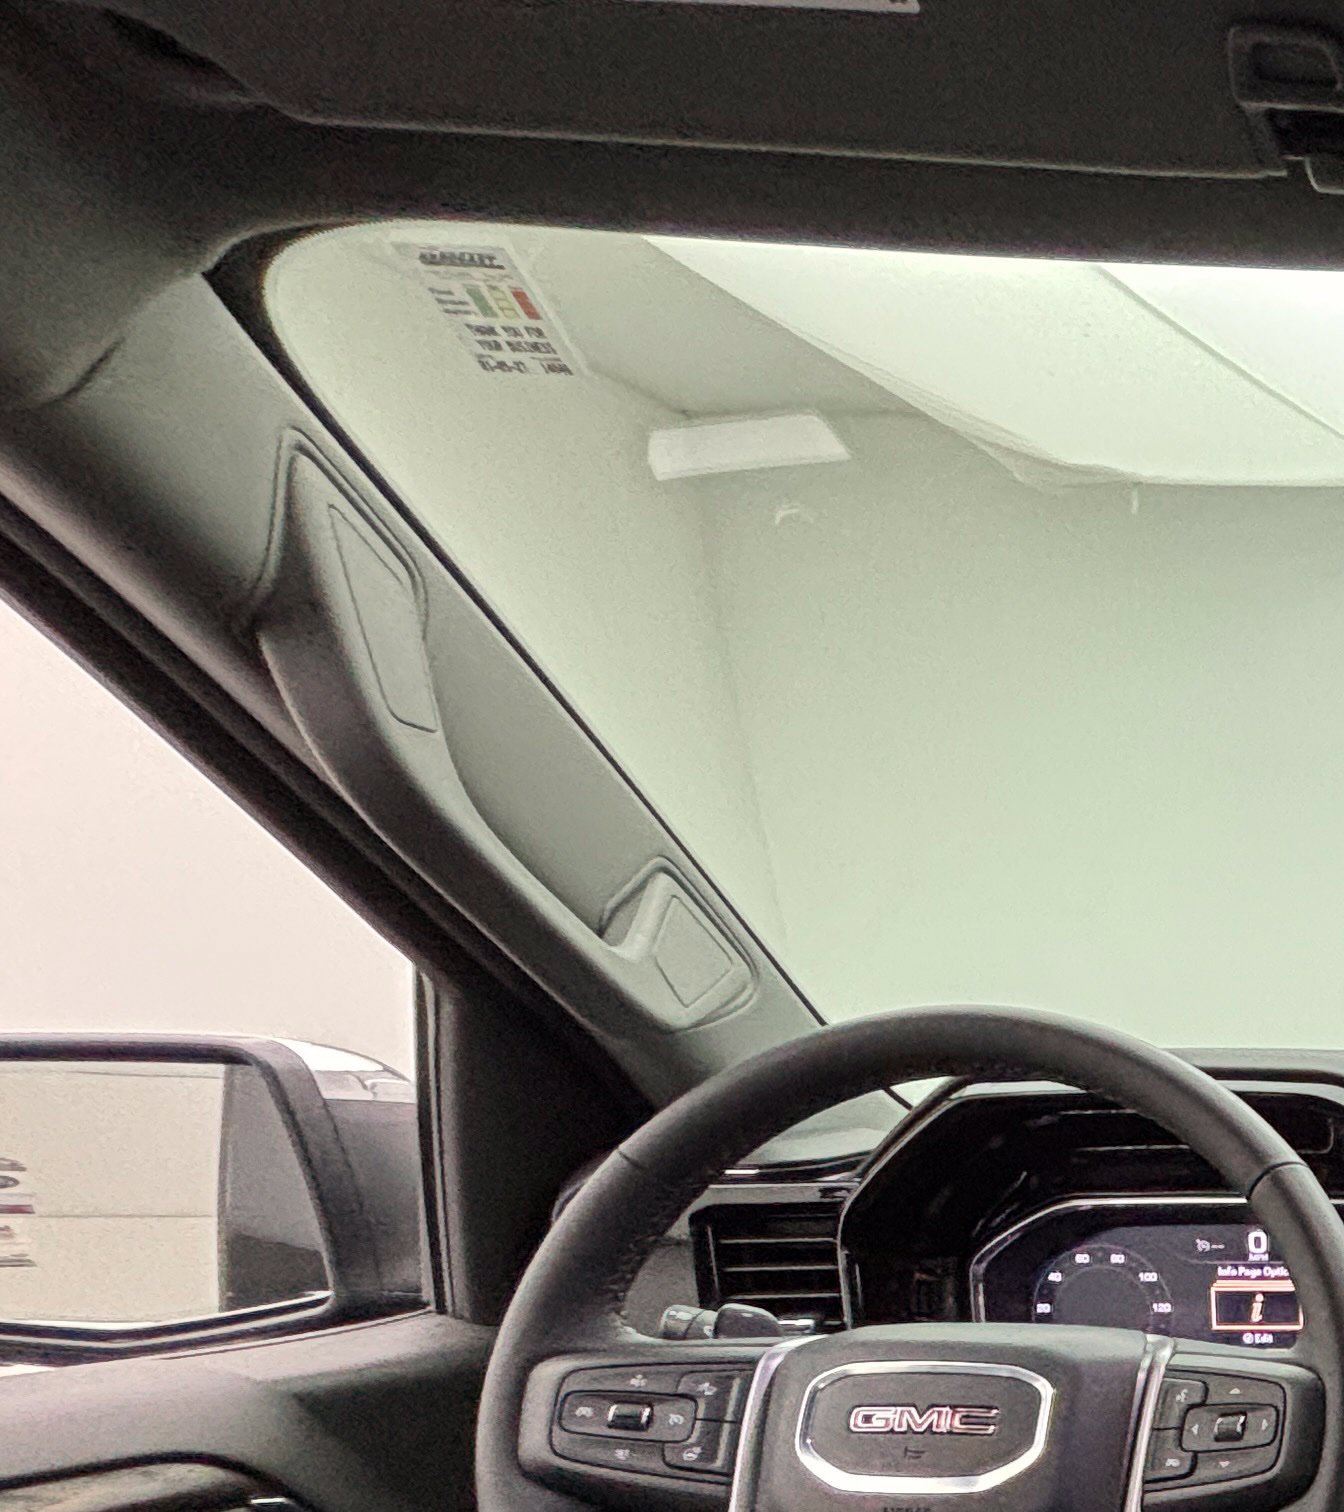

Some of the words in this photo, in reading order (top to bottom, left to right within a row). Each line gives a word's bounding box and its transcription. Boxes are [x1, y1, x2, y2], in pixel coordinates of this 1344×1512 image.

[1248, 1231, 1268, 1254] 0
[1217, 1266, 1237, 1277] Info
[1238, 1266, 1262, 1278] Page
[1153, 1302, 1172, 1314] 120
[849, 1404, 1000, 1435] GMC
